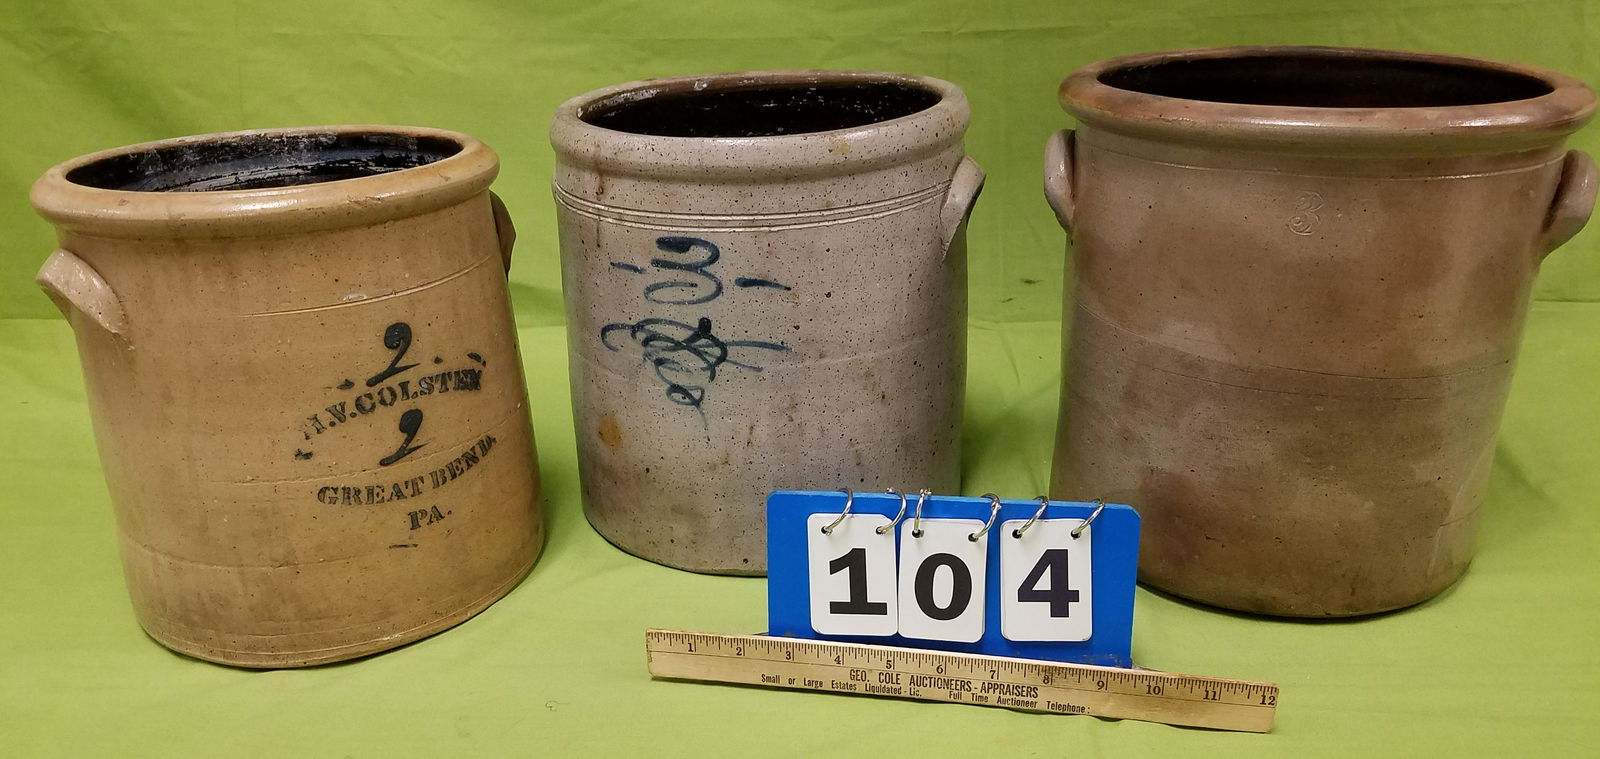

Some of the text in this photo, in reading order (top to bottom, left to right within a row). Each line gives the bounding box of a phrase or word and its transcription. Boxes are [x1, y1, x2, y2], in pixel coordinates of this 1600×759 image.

[1285, 190, 1324, 236] 3
[366, 322, 421, 388] 2
[379, 408, 430, 467] 2
[317, 476, 425, 505] GREAT
[407, 505, 452, 530] PA.
[736, 646, 742, 656] 2
[785, 650, 791, 661] 3
[834, 655, 841, 665] 4
[885, 660, 892, 670] 5
[936, 664, 943, 675] 6
[990, 669, 996, 679] 7
[1043, 674, 1049, 684] 8
[1097, 680, 1104, 690] 9
[1146, 684, 1161, 696] 10
[1202, 689, 1217, 701] 11
[1260, 694, 1275, 706] 12
[761, 673, 781, 684] Small
[788, 677, 796, 686] or
[803, 677, 823, 689] Large
[831, 679, 857, 691] Estates
[865, 683, 901, 695] Liquidated
[909, 688, 922, 697] Lic.
[949, 690, 962, 701] Full
[971, 692, 989, 703] Time
[997, 695, 1038, 709] Auctioneer
[849, 668, 870, 683] GEO.
[878, 671, 901, 686] COLE
